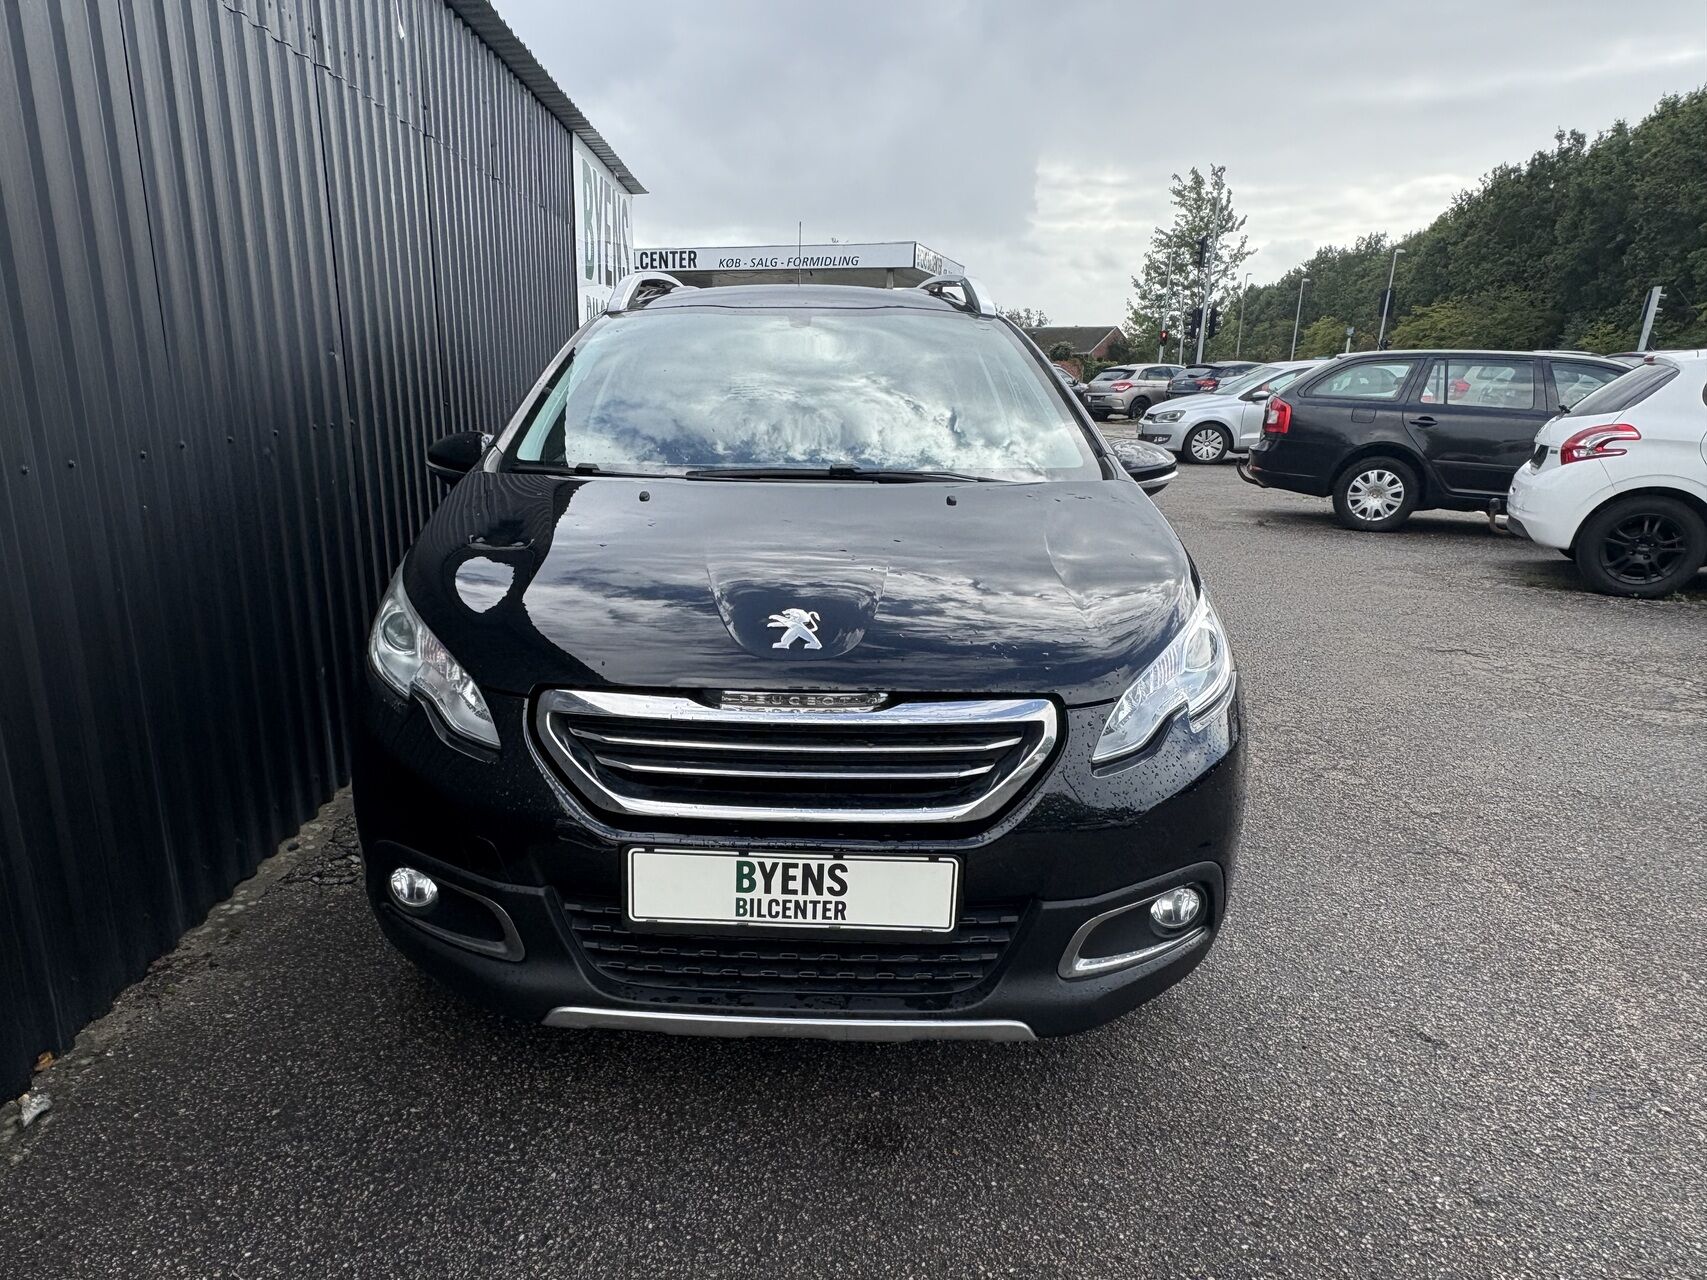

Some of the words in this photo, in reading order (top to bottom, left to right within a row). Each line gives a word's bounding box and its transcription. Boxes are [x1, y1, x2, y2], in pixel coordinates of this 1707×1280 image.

[582, 158, 631, 288] BYENS
[718, 258, 741, 268] KØB
[750, 257, 778, 268] SALG
[786, 255, 860, 268] FORMIDLING
[735, 860, 848, 896] BYENS
[735, 897, 847, 920] BILCENTER
